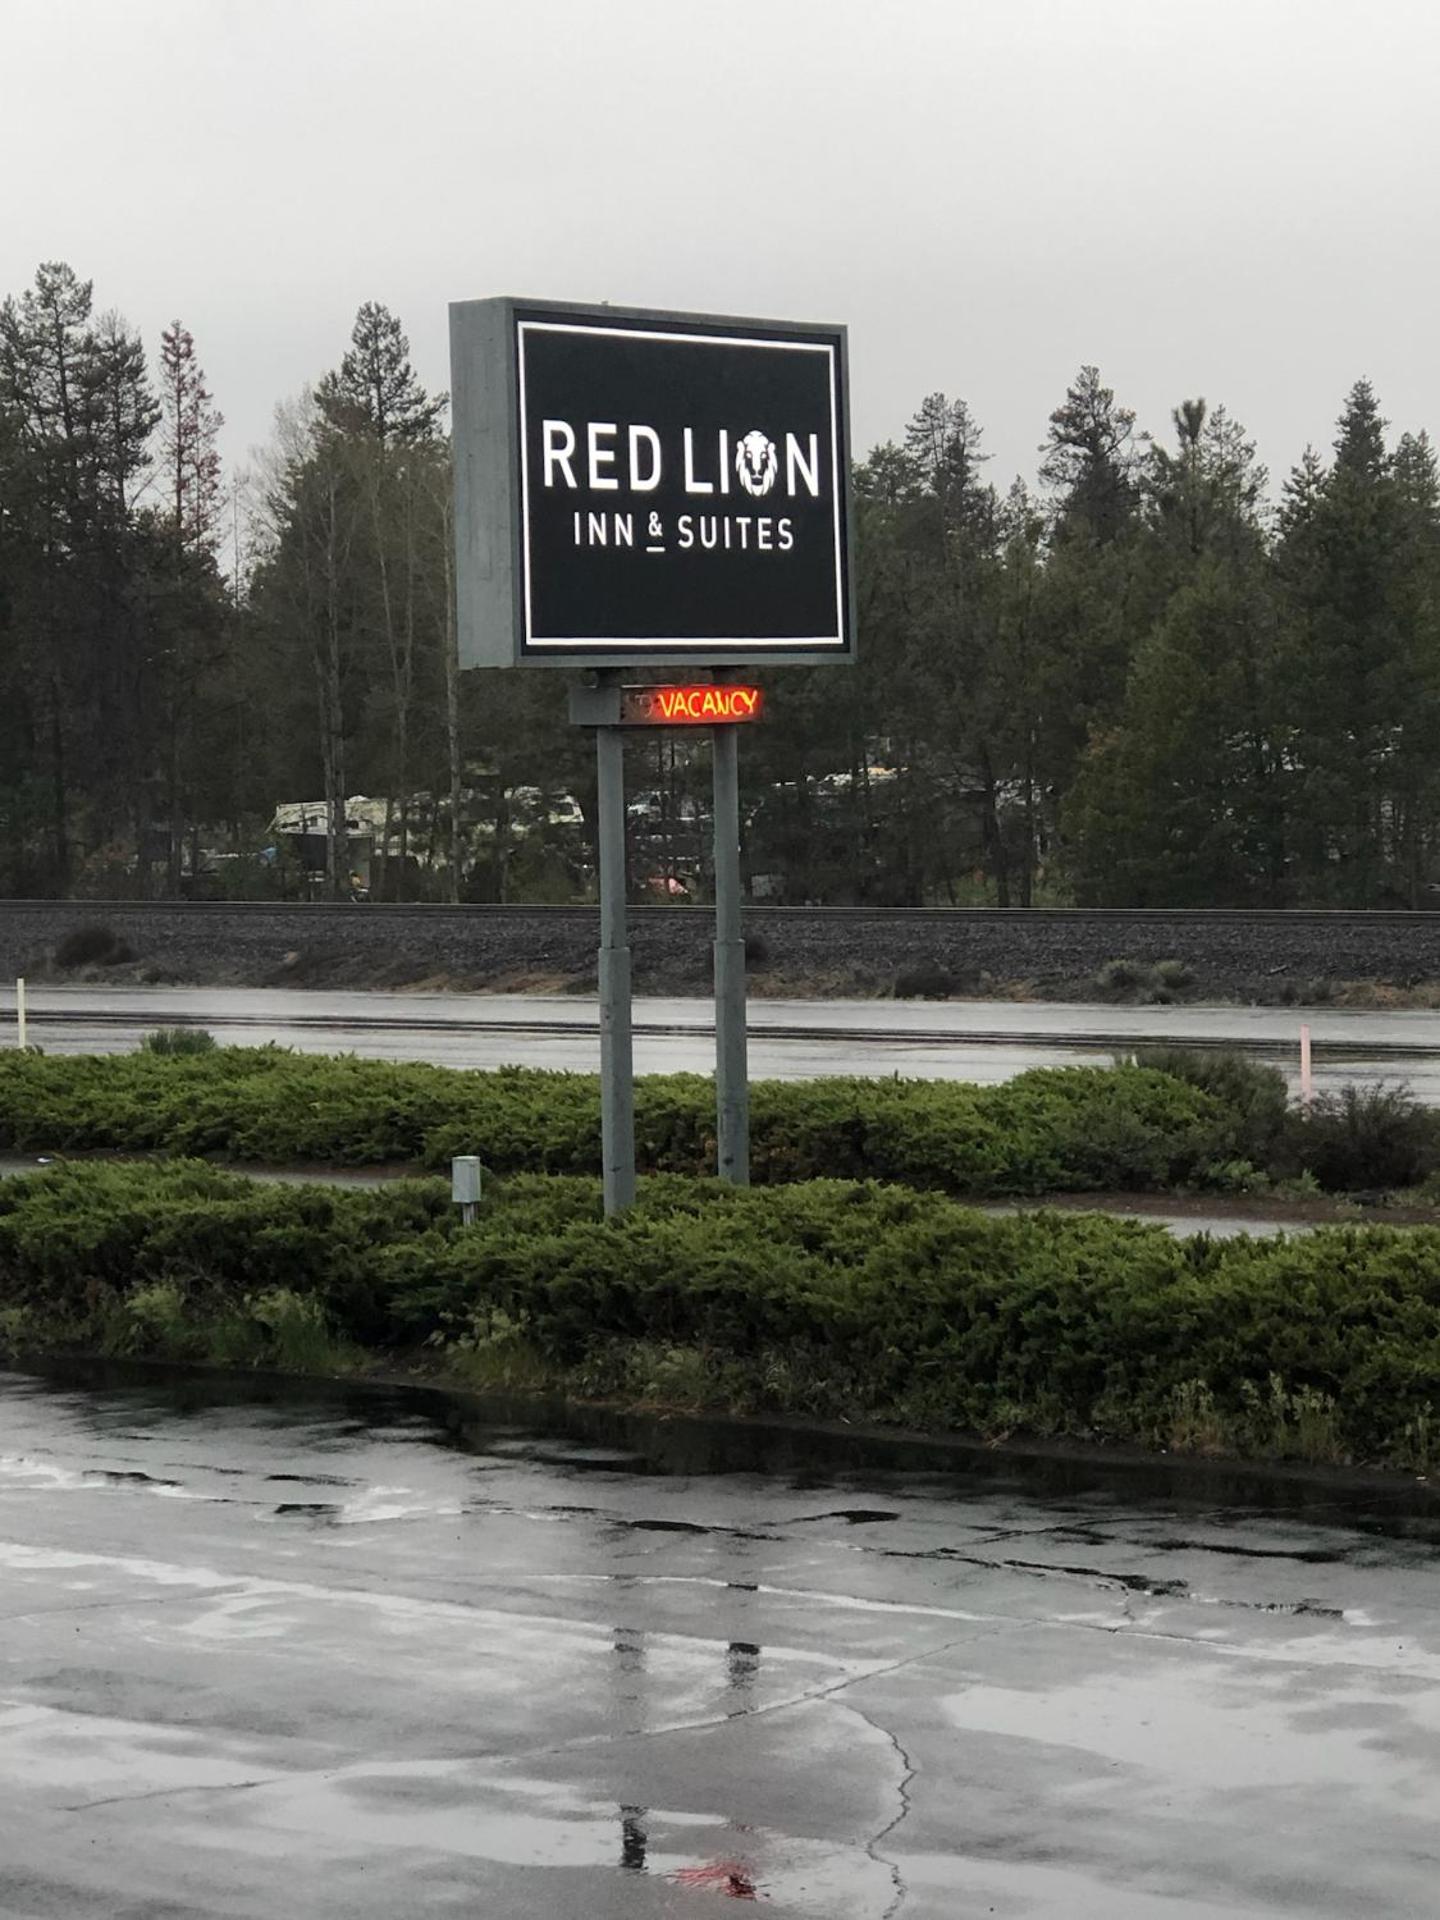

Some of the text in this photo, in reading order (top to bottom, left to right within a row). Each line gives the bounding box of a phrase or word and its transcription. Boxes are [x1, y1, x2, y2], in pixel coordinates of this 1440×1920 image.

[542, 419, 662, 492] RED
[574, 511, 794, 553] INN & SUITES
[658, 690, 758, 718] VACANCY
